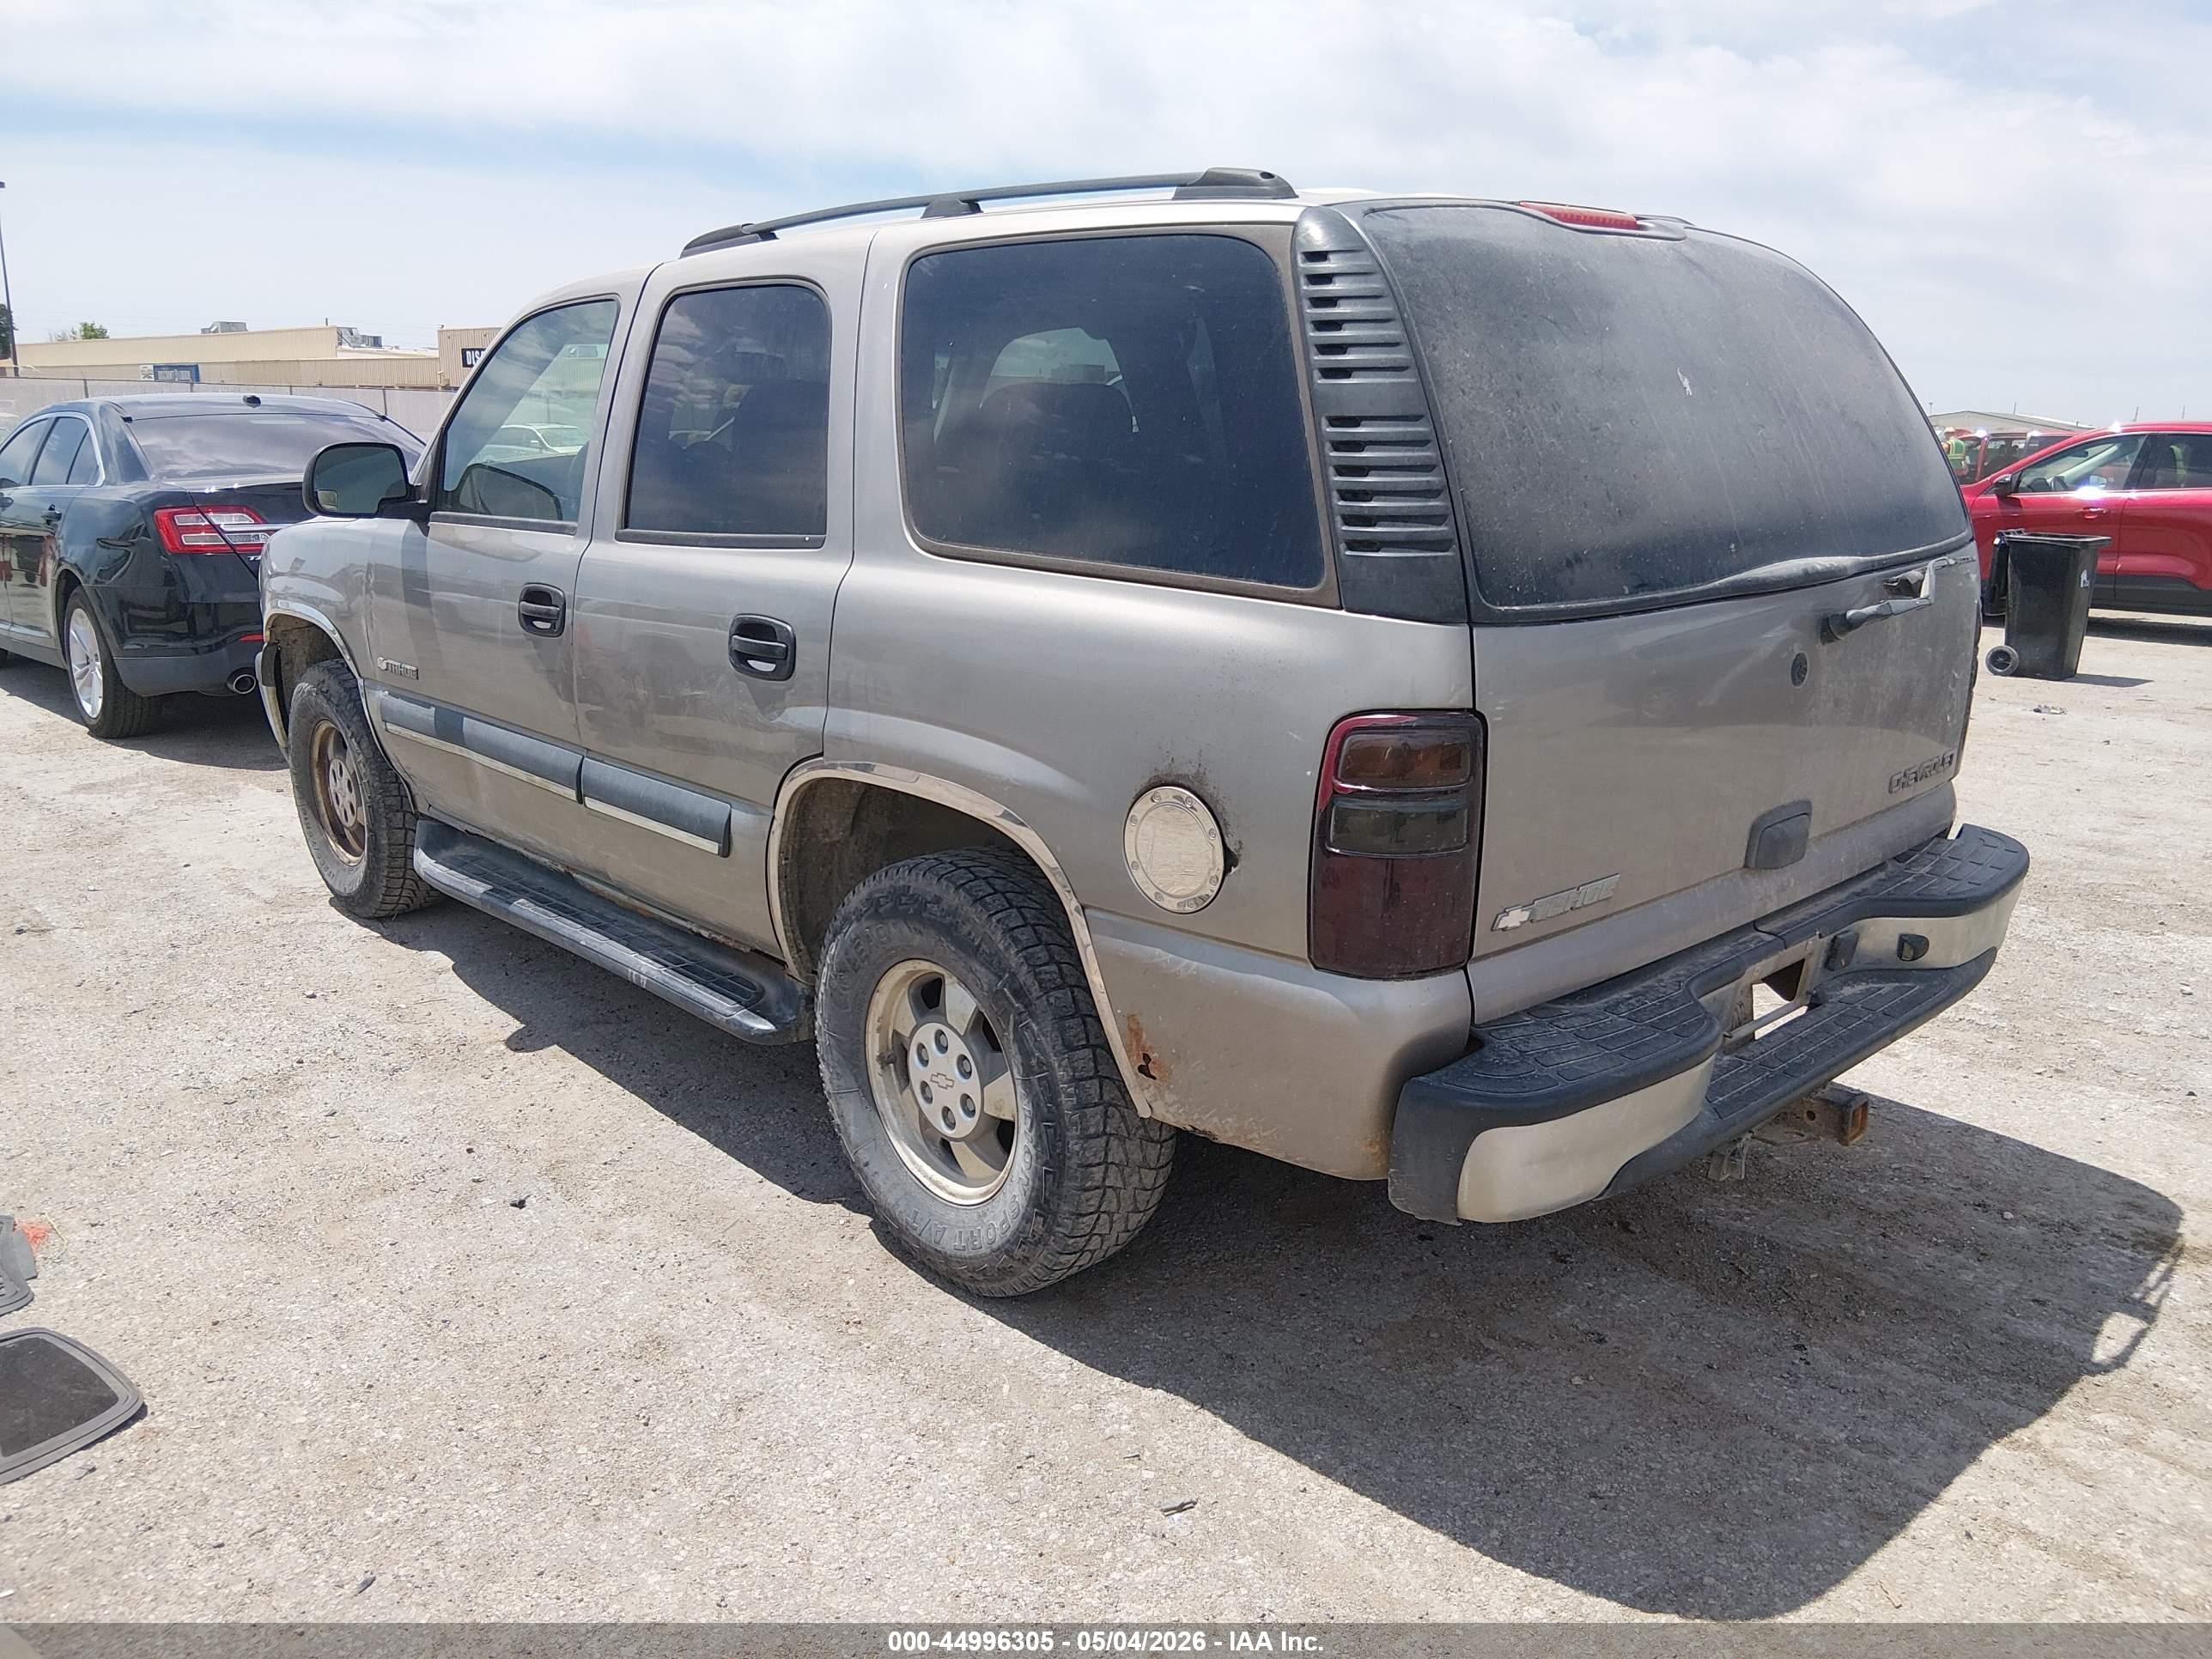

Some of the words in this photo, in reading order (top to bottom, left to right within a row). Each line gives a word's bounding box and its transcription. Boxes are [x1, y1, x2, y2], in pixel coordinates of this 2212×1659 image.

[465, 350, 486, 365] DIS
[385, 659, 419, 680] TAHOE
[1532, 873, 1620, 921] TAHOE
[953, 1194, 1020, 1251] SPORT
